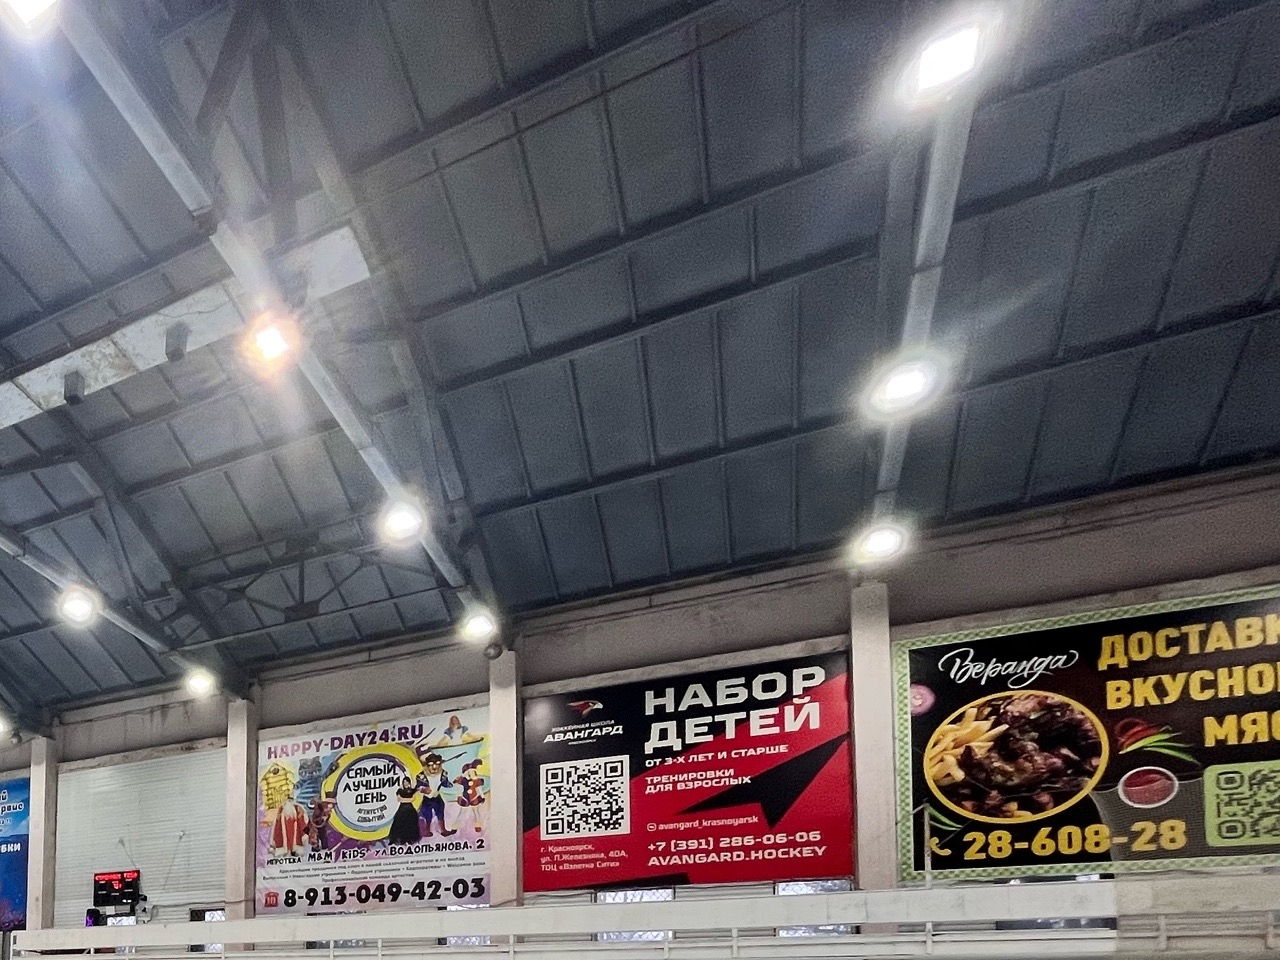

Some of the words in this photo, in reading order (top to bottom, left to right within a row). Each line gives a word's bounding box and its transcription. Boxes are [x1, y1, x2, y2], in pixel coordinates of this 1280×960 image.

[938, 648, 1079, 689] Веранда
[645, 666, 826, 715] НАБОР
[1106, 662, 1280, 710] ВКУСНО
[543, 725, 624, 743] АВАНГАРД
[644, 696, 820, 754] ДЕТЕЙ
[267, 723, 424, 760] HAPPY-DAY24.RU
[645, 758, 662, 767] ОТ
[664, 756, 686, 765] 3-Х
[688, 753, 715, 763] ЛЕТ
[717, 751, 727, 759] И
[731, 744, 789, 758] СТАРШЕ
[347, 761, 397, 779] САМЫЙ
[645, 768, 735, 785] ТРЕНИРОВКИ
[645, 783, 673, 795] ДЛЯ
[676, 775, 751, 790] ВЗРОСЛЫХ
[355, 791, 387, 804] ДЕНЬ
[658, 815, 759, 831] avangard_krasnoyarsk
[647, 841, 667, 852] +7
[719, 830, 822, 848] 286-06-06
[963, 820, 1187, 860] 28-608-28
[266, 857, 302, 866] ИГРОТЕКА
[476, 838, 485, 849] 2
[647, 845, 828, 867] AVANGARD.HOCKEY
[540, 863, 557, 872] ТОЦ
[283, 878, 486, 908] 8-913-049-42-03
